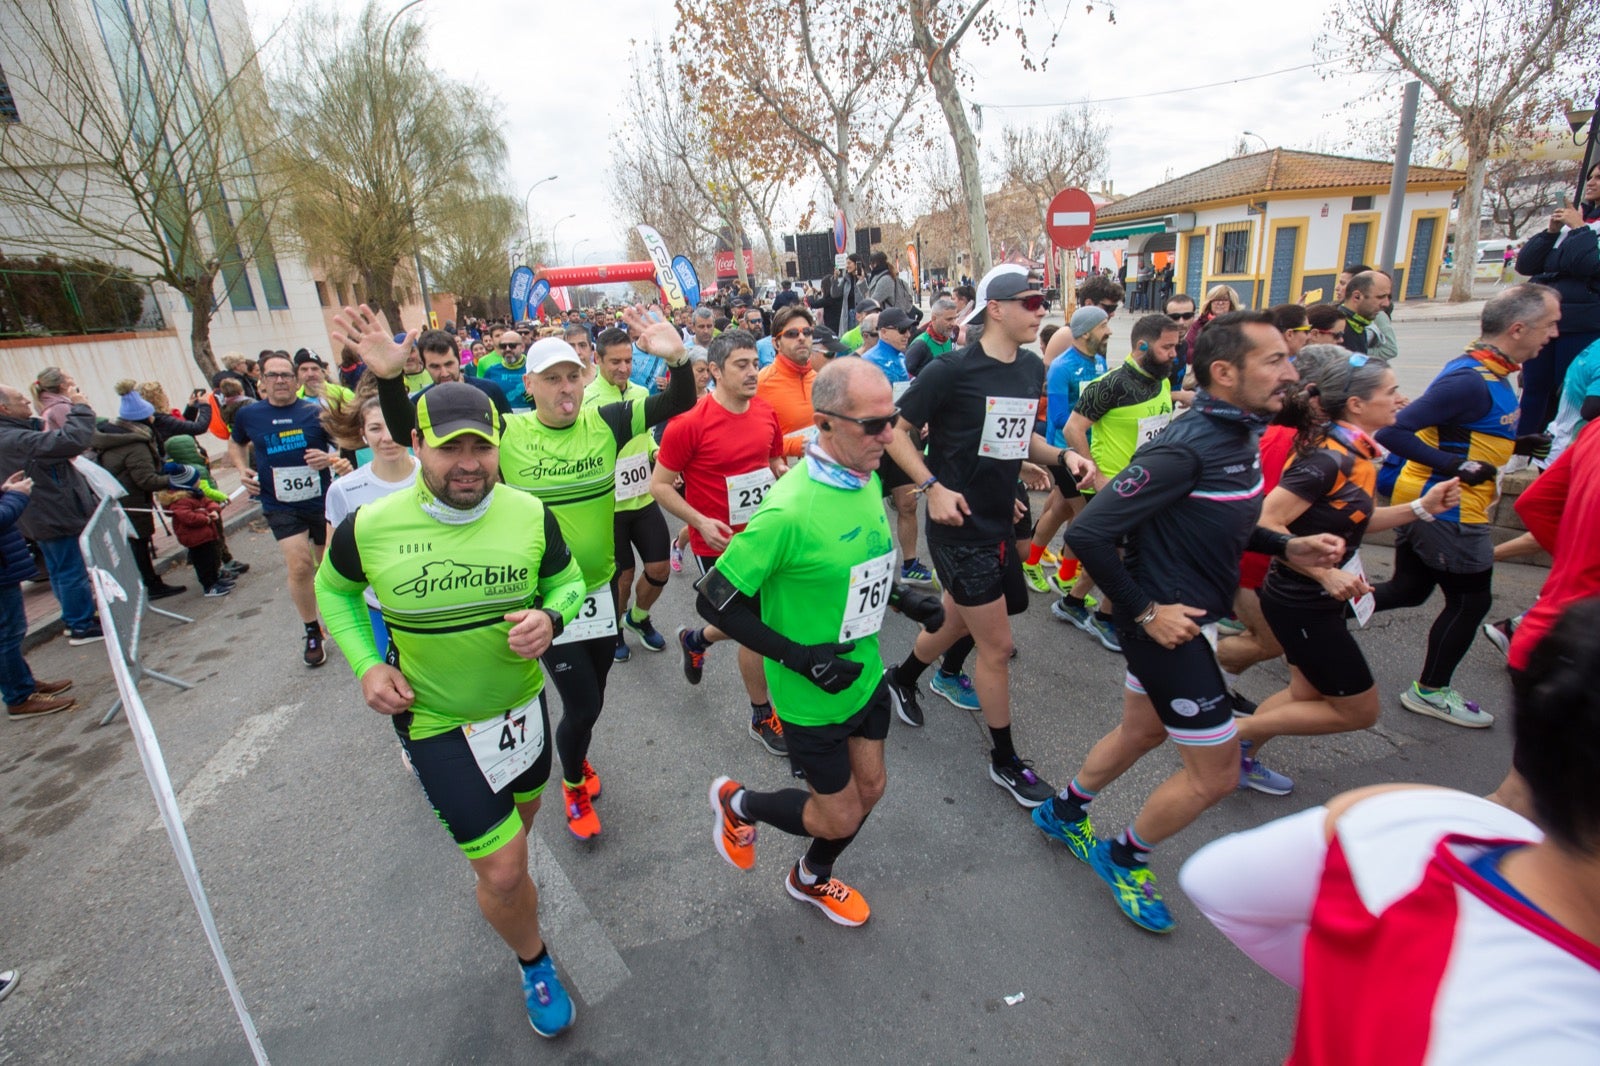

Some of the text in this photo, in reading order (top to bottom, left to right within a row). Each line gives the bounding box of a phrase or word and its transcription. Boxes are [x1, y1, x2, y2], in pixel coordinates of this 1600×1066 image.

[996, 417, 1027, 439] 373
[267, 441, 308, 455] MARCELINO
[281, 434, 305, 444] PADRE
[283, 475, 314, 491] 364
[620, 466, 648, 486] 300
[399, 542, 433, 554] GOBIK
[859, 576, 889, 614] 767
[498, 714, 527, 752] 47
